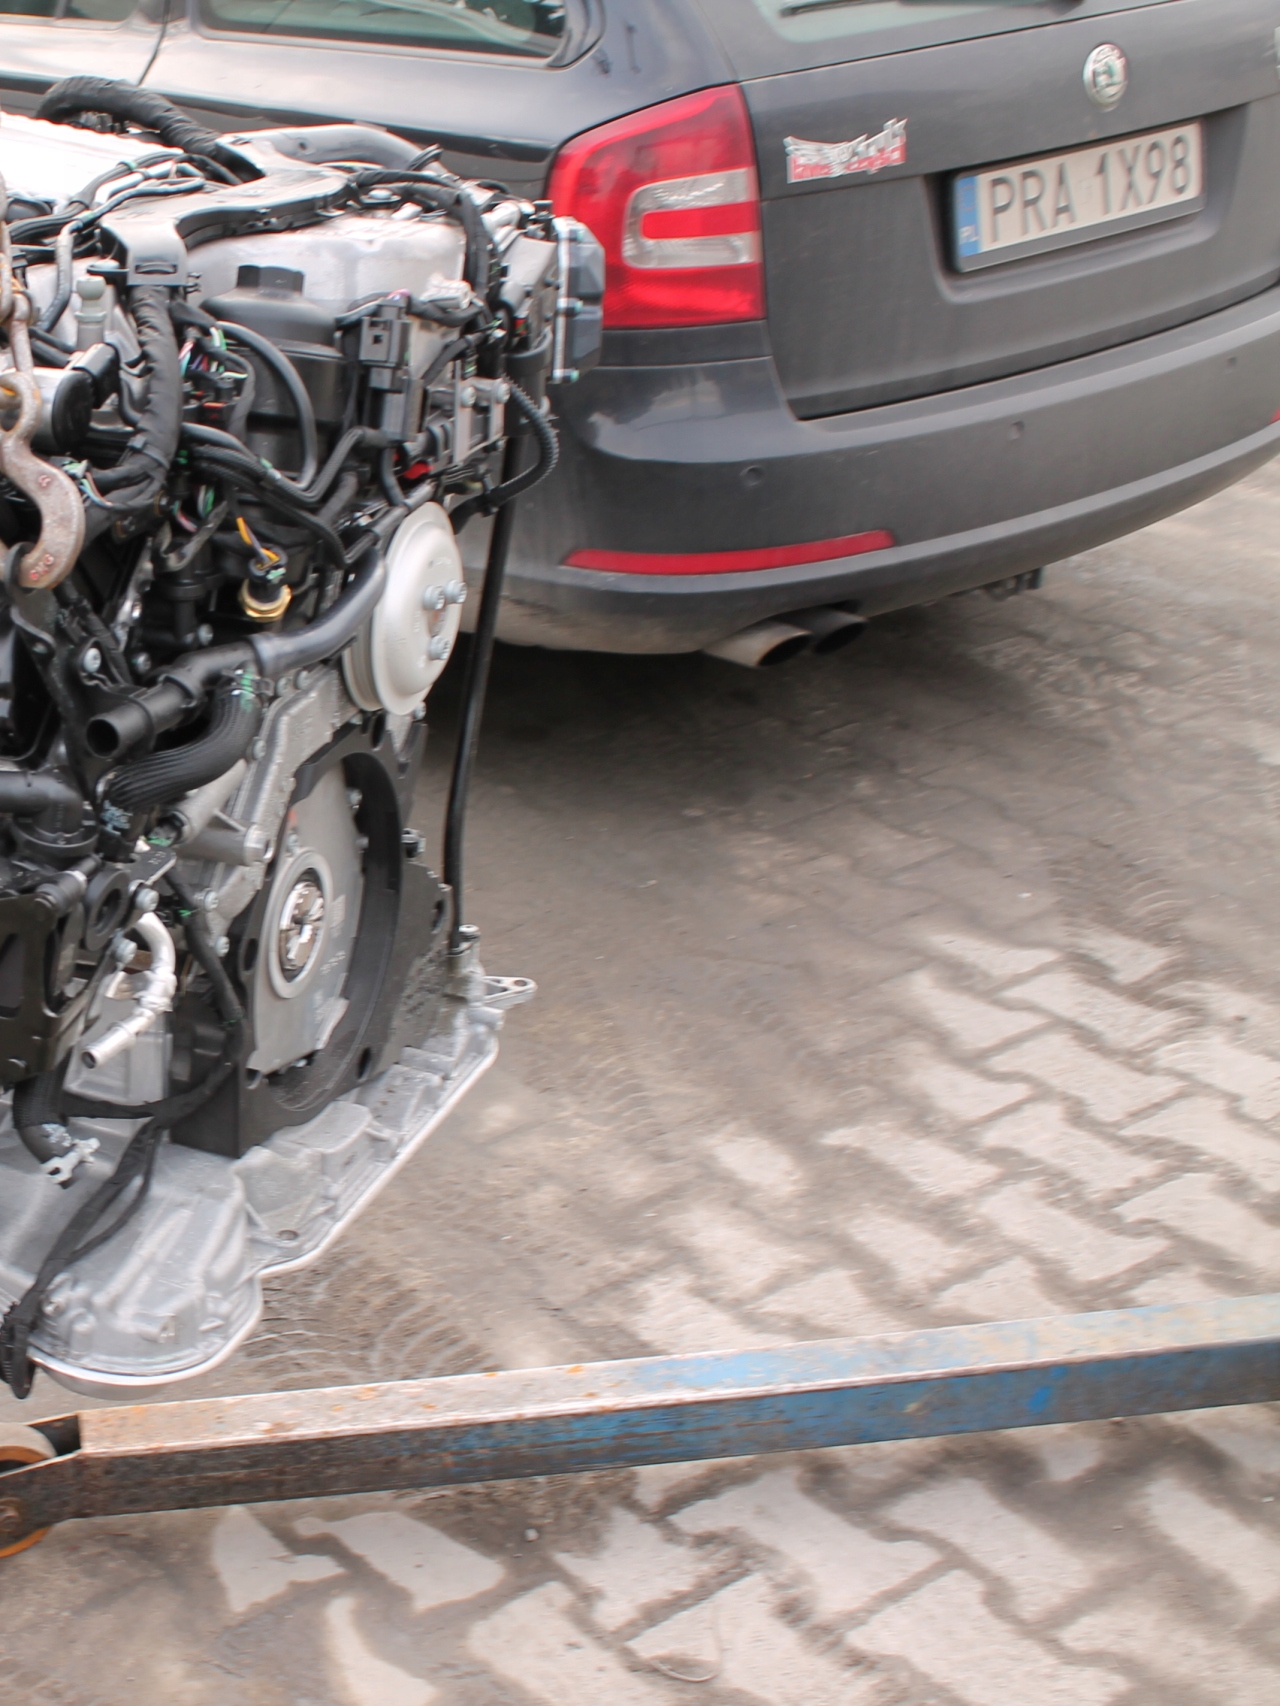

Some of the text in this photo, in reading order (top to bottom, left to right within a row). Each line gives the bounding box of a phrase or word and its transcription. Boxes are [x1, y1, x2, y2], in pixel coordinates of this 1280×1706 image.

[989, 134, 1191, 243] PRA 1X98
[959, 225, 979, 245] PL
